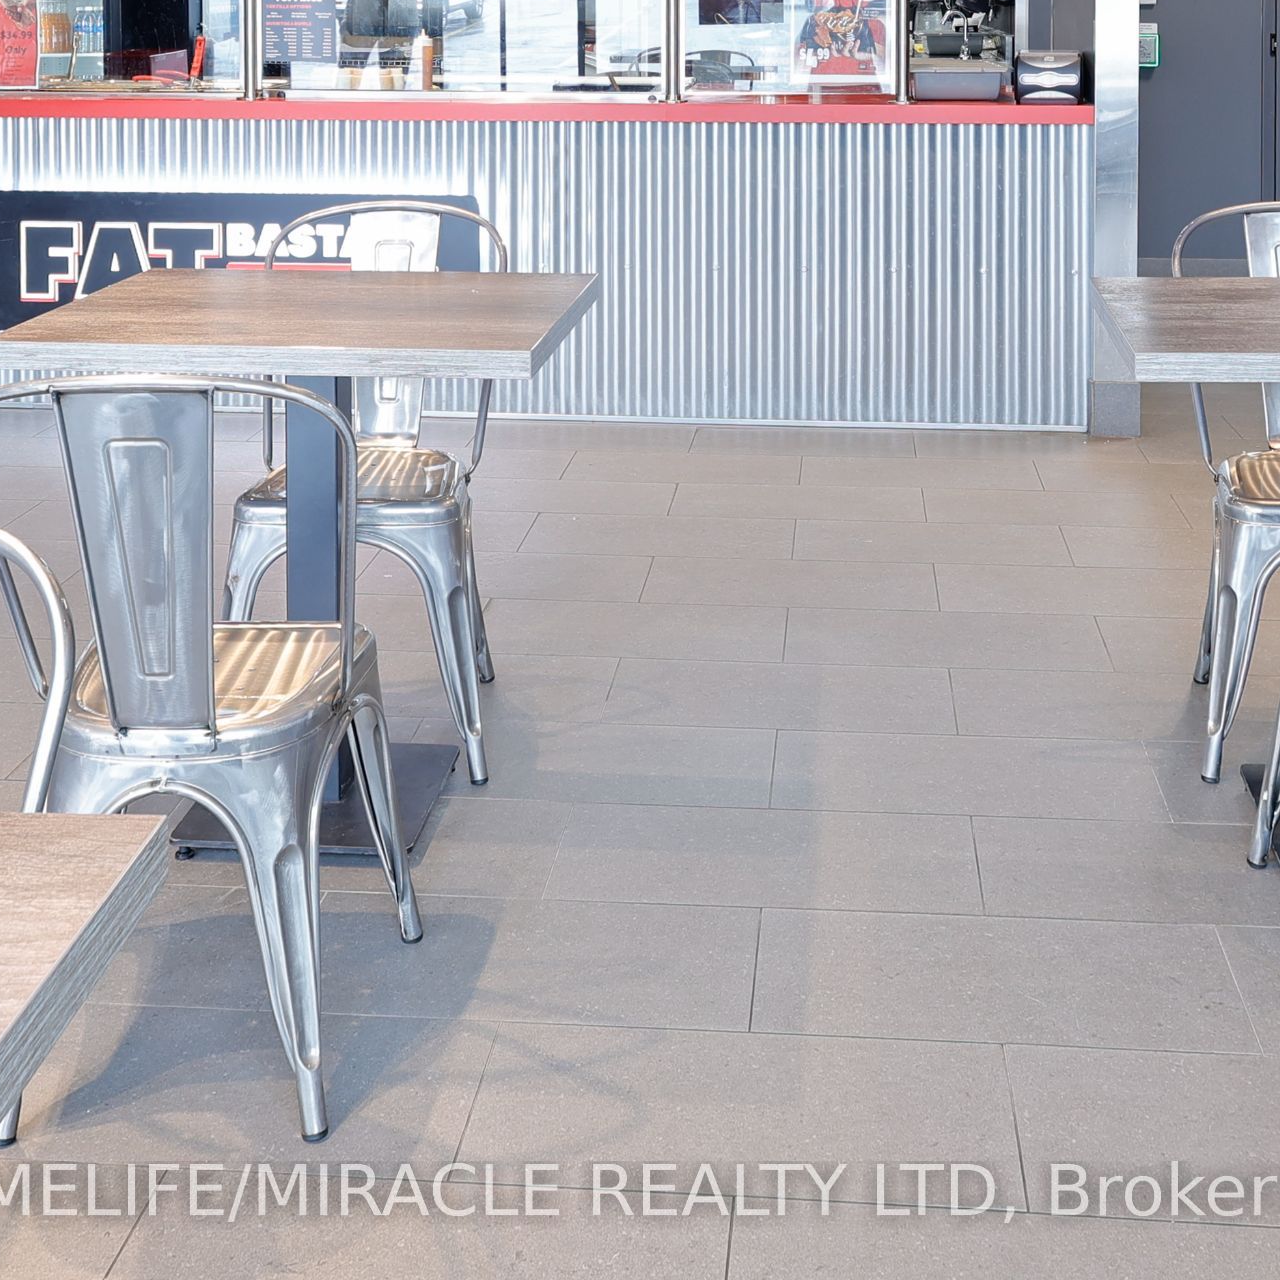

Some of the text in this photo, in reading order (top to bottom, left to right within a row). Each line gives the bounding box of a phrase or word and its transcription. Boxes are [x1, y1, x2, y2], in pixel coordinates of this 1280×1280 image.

[0, 30, 32, 40] $34.99
[5, 46, 26, 56] Only
[20, 220, 222, 302] FAT
